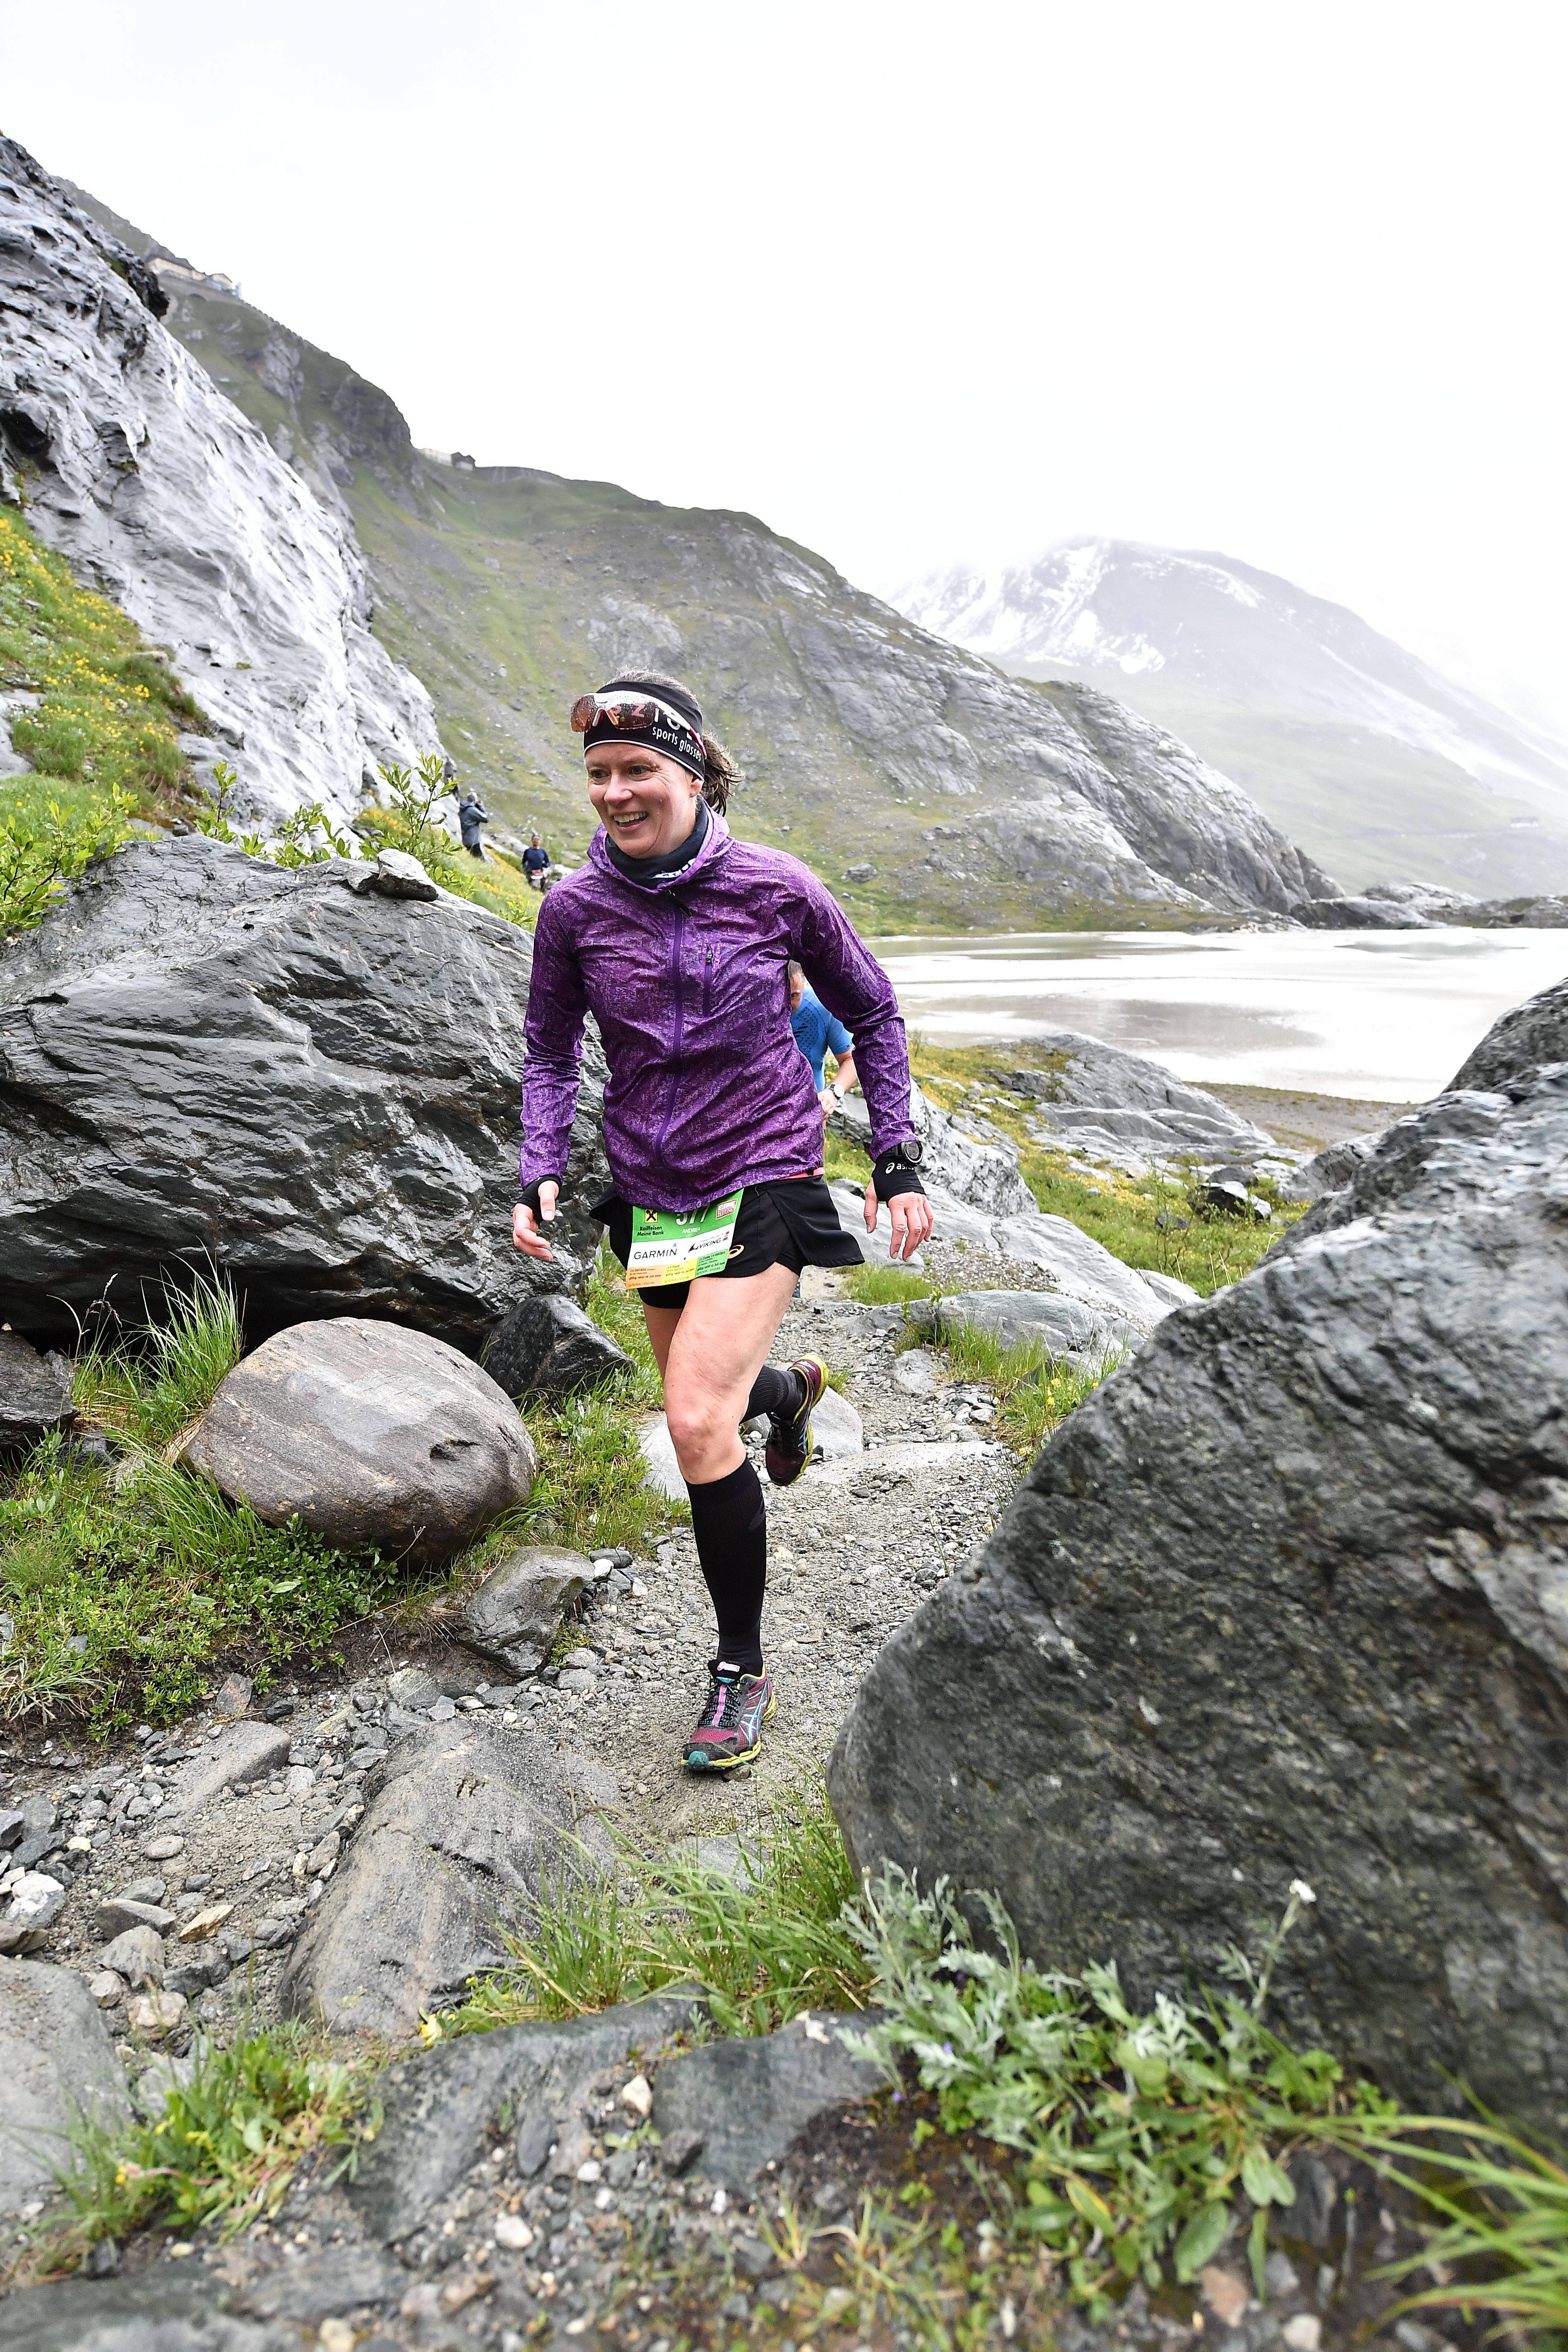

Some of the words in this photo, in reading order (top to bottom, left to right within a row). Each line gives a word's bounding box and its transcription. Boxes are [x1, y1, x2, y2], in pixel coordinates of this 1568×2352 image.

[652, 726, 679, 745] sports
[678, 739, 702, 762] glasses
[700, 1237, 721, 1249] VIKING
[634, 1249, 678, 1259] GARMIN
